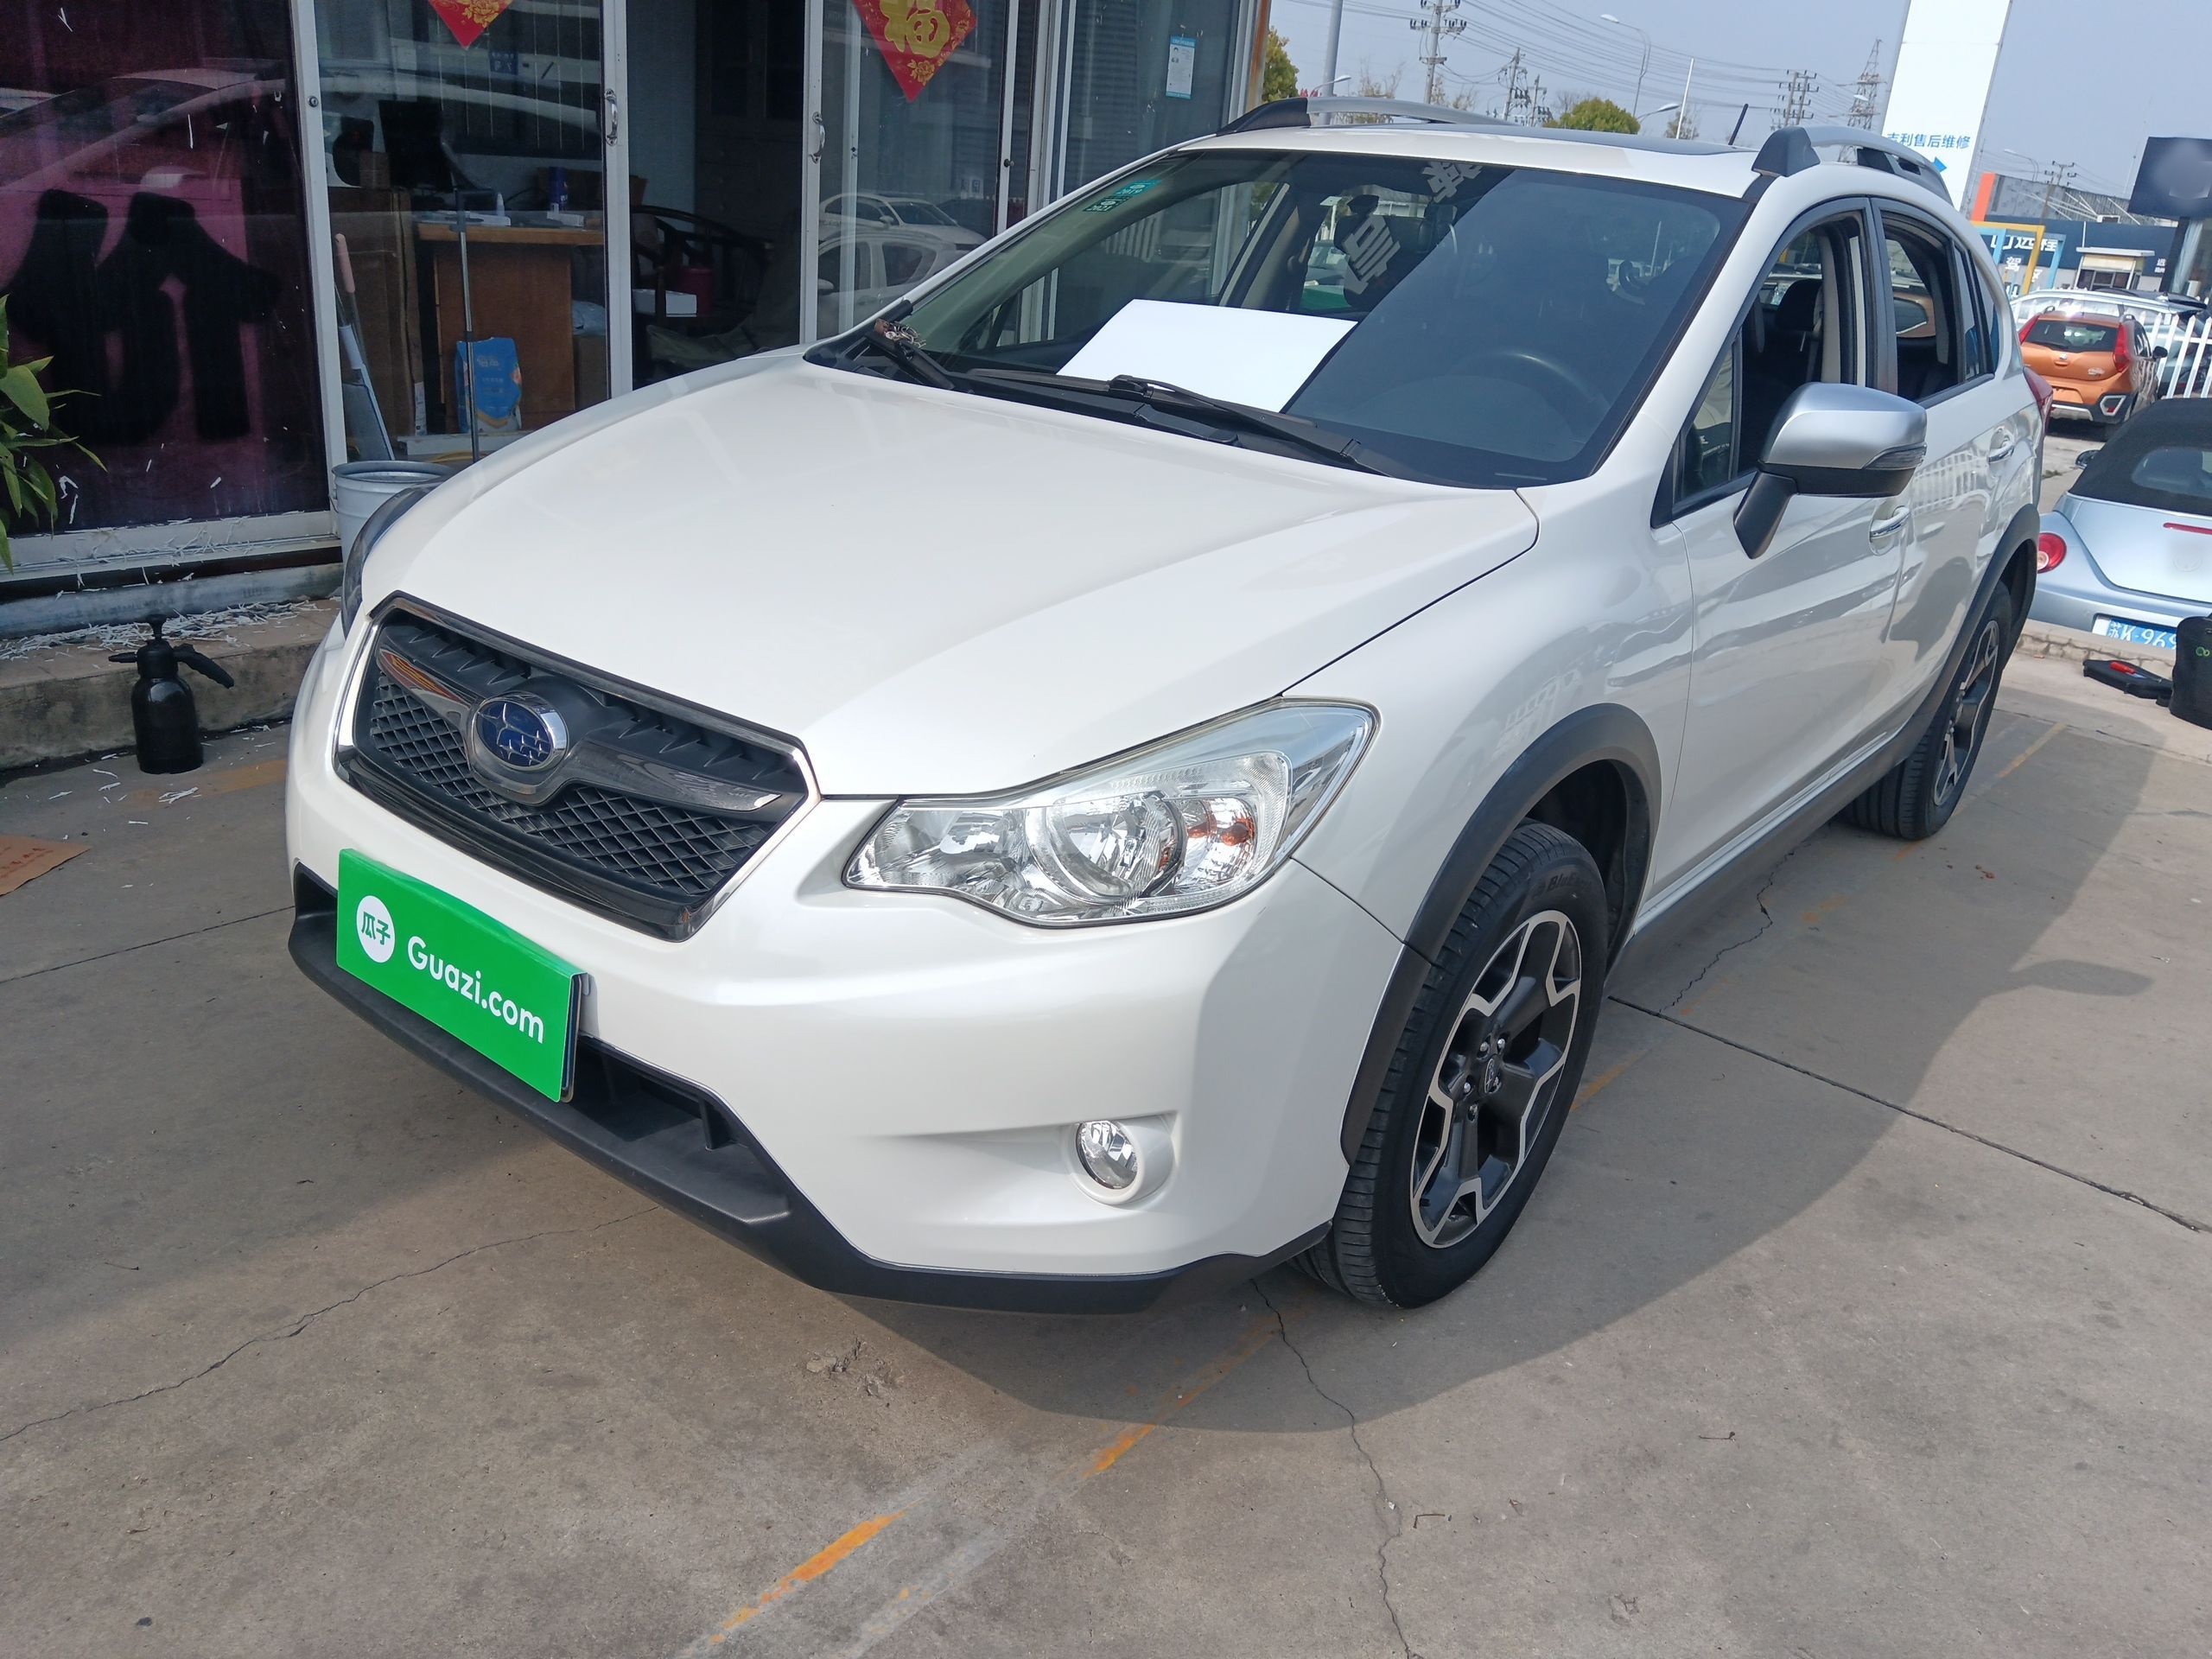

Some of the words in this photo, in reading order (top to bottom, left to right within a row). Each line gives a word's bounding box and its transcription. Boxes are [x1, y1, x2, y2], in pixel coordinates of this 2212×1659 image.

[880, 0, 950, 59] 福
[360, 911, 391, 945] 瓜子
[407, 935, 544, 1044] Guazi.com
